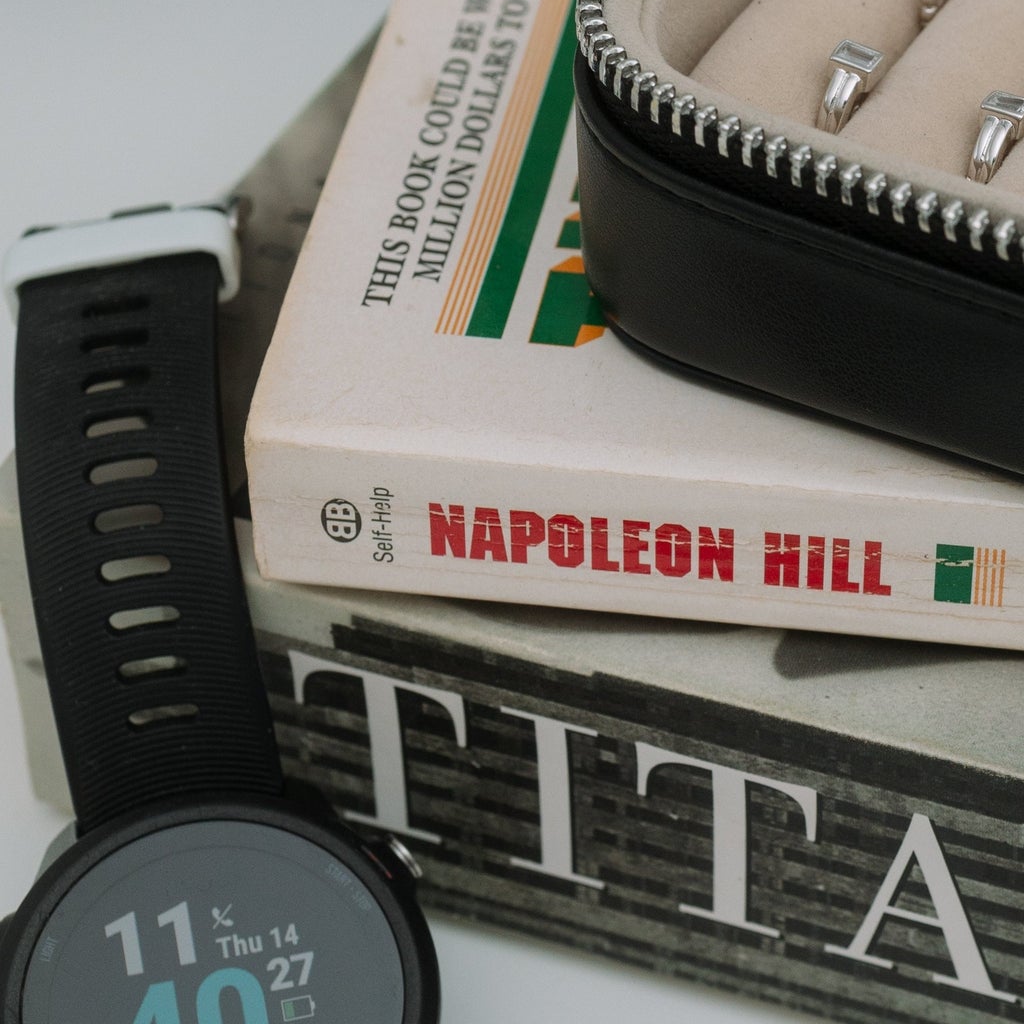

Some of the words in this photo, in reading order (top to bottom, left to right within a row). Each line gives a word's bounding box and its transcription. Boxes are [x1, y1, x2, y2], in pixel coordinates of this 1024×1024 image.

[361, 239, 410, 306] THIS
[389, 152, 440, 234] BOOK
[419, 57, 471, 146] COULD
[451, 19, 486, 52] BE
[412, 159, 477, 282] MILLION
[455, 37, 517, 154] DOLLARS
[369, 486, 394, 563] Self-Help
[428, 501, 734, 583] NAPOLEON
[763, 531, 892, 596] HILL
[104, 901, 197, 976] 11
[215, 934, 263, 959] Thu
[269, 923, 299, 948] 14
[266, 951, 314, 991] 27
